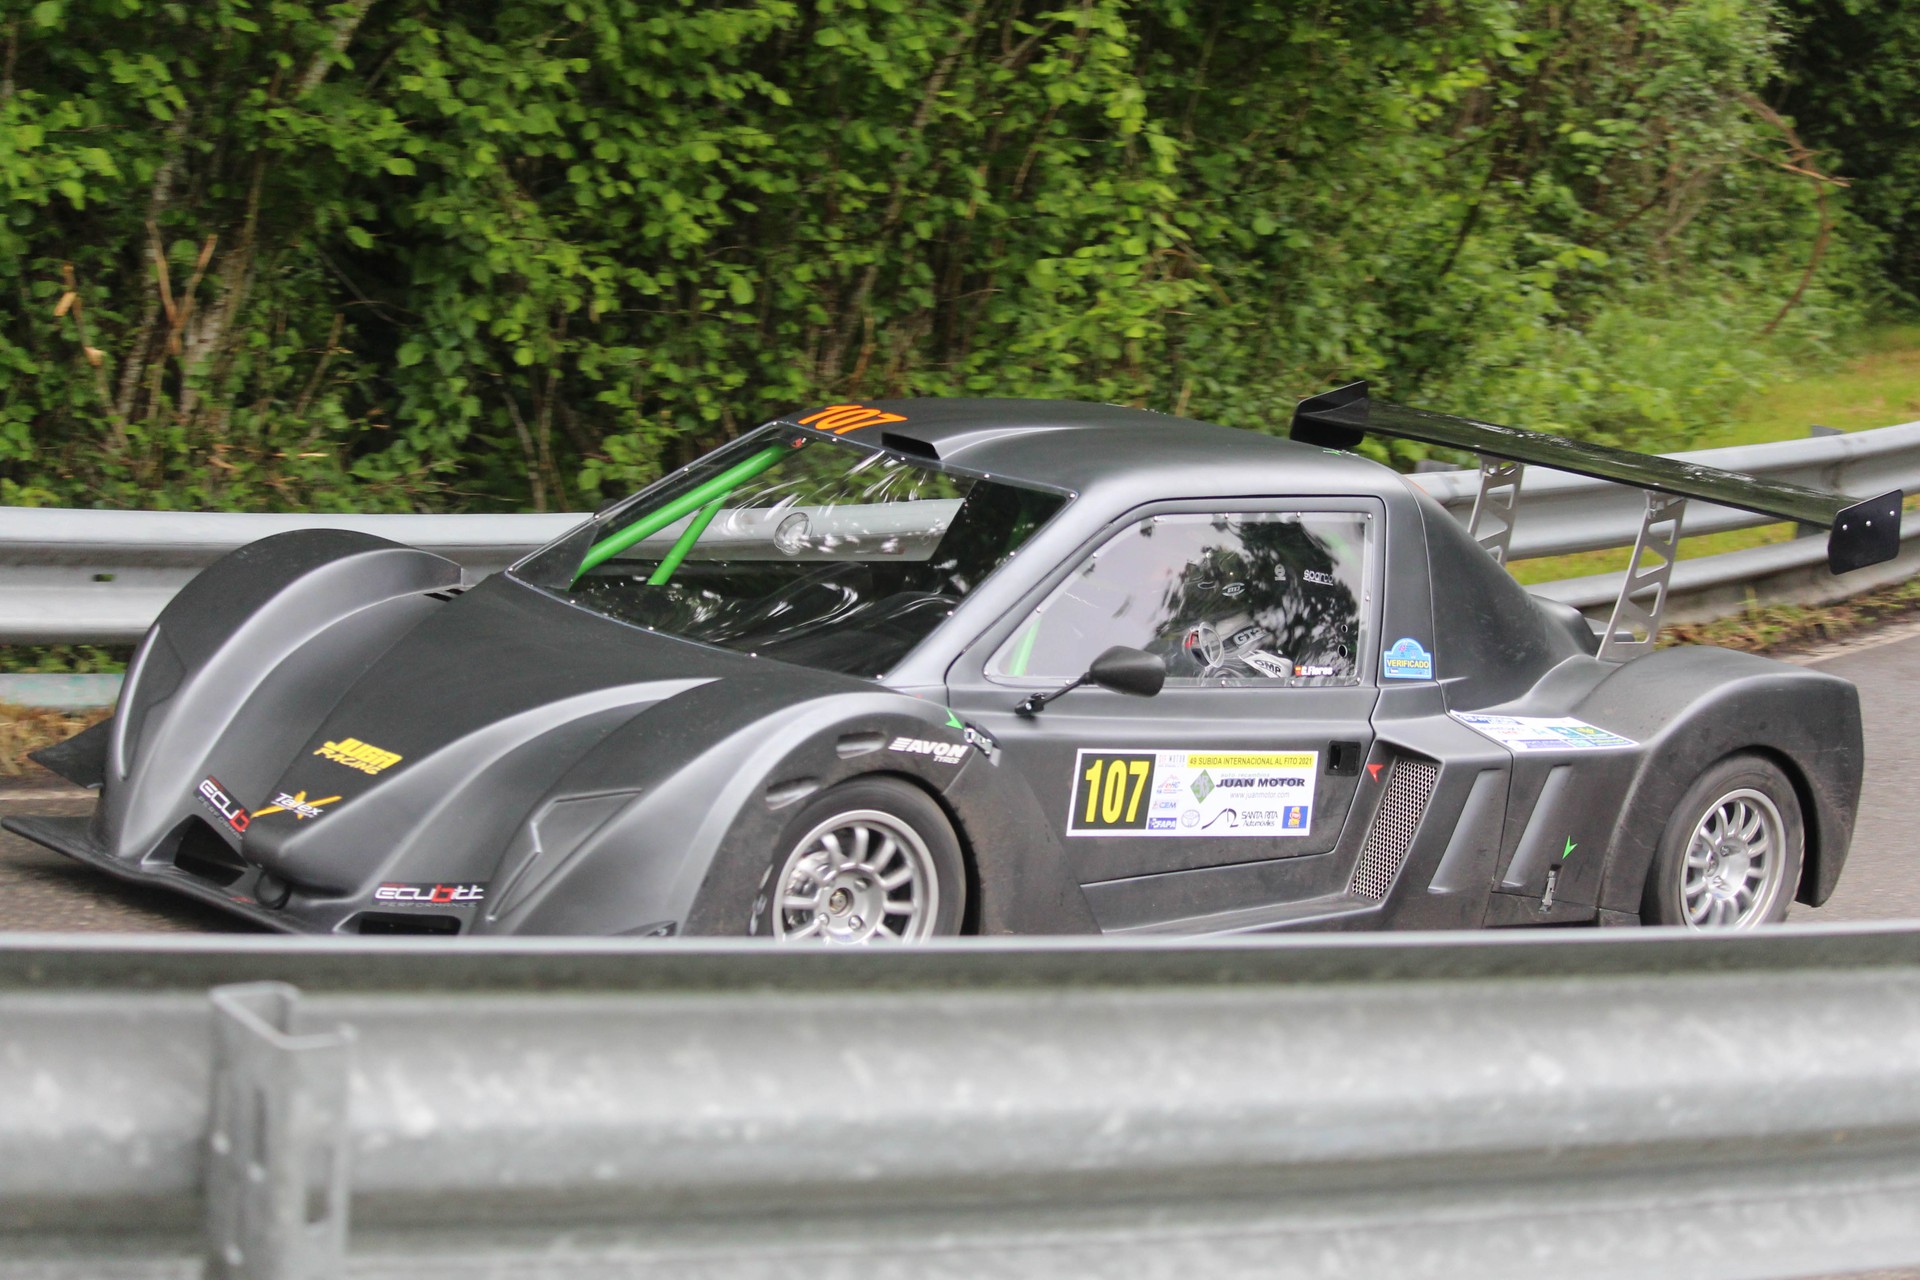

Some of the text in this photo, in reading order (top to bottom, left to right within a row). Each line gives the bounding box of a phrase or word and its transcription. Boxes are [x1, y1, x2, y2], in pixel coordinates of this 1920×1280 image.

[798, 405, 908, 434] 107
[1303, 569, 1333, 585] sparco
[1387, 659, 1429, 669] VERIFICADO
[906, 740, 968, 757] AVON
[313, 746, 383, 775] RACING
[933, 755, 960, 764] TYRES
[1198, 757, 1222, 765] SUBIDA
[1223, 757, 1274, 765] INTERNACIONAL
[1274, 757, 1283, 765] AL
[1284, 757, 1298, 765] FITO
[1298, 757, 1312, 765] 2021
[1085, 759, 1150, 823] 107
[1215, 778, 1305, 788] JUAN MOTOR
[274, 792, 324, 816] Talex
[1241, 811, 1278, 819] SANTA RITA
